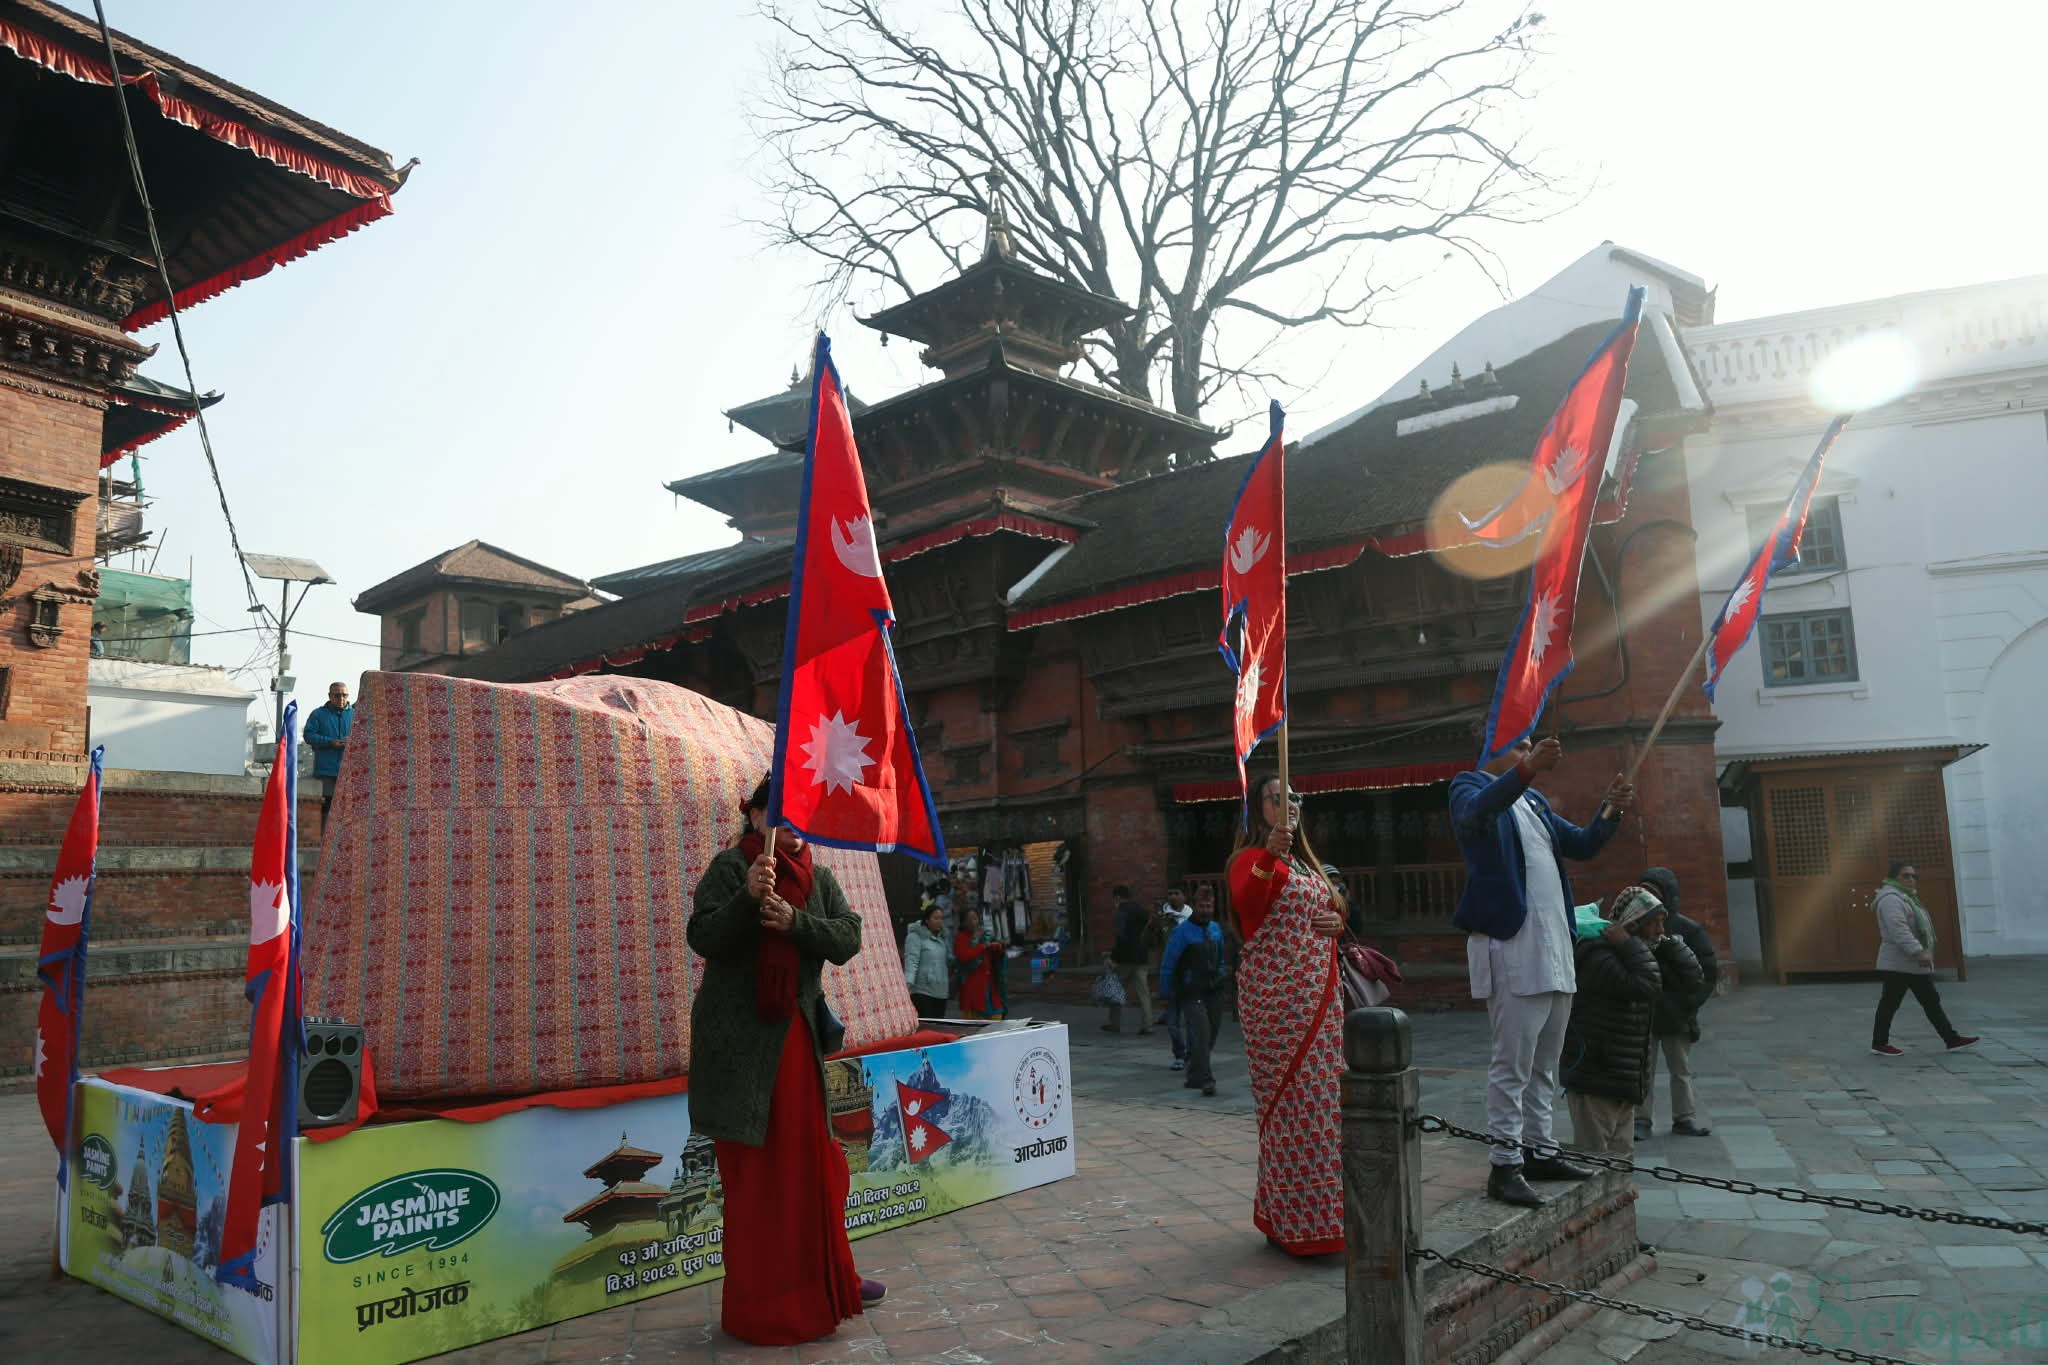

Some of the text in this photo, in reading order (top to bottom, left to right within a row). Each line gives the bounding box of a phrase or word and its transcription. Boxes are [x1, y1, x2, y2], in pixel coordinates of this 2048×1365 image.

[1013, 1135, 1068, 1163] आयोजक
[356, 1187, 470, 1226] JASMINE
[863, 1188, 890, 1204] दिवस
[879, 1203, 905, 1220] 2026
[907, 1197, 927, 1212] AD)
[373, 1208, 460, 1241] PAINTS
[619, 1251, 637, 1265] १३
[641, 1240, 659, 1261] औ
[663, 1234, 705, 1255] राष्ट्रिय
[682, 1254, 704, 1275] पुस
[352, 1253, 469, 1288] SINCE 1994
[355, 1280, 471, 1333] प्रायोजक
